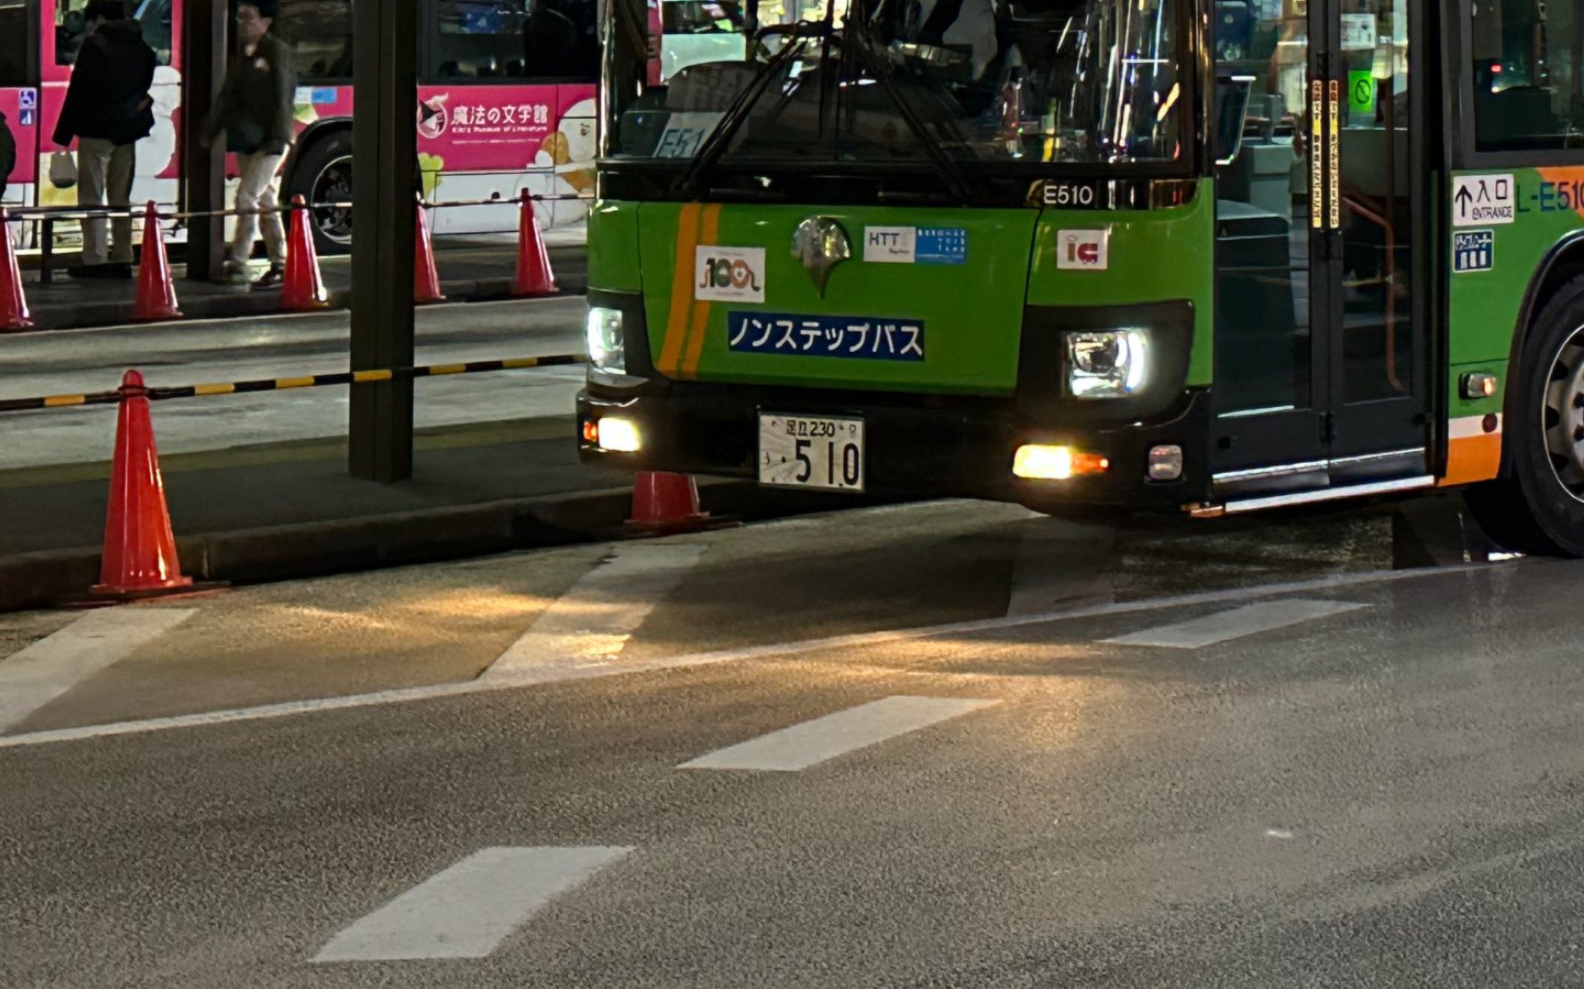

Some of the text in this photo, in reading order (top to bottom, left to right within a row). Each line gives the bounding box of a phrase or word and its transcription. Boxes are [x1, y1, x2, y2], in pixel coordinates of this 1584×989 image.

[450, 104, 548, 125] 魔法の文学館
[1043, 185, 1094, 205] E510
[1476, 179, 1508, 203] 入口
[1472, 206, 1513, 221] ENTRANCE
[730, 318, 923, 356] ノンステップバス
[810, 420, 836, 438] 230
